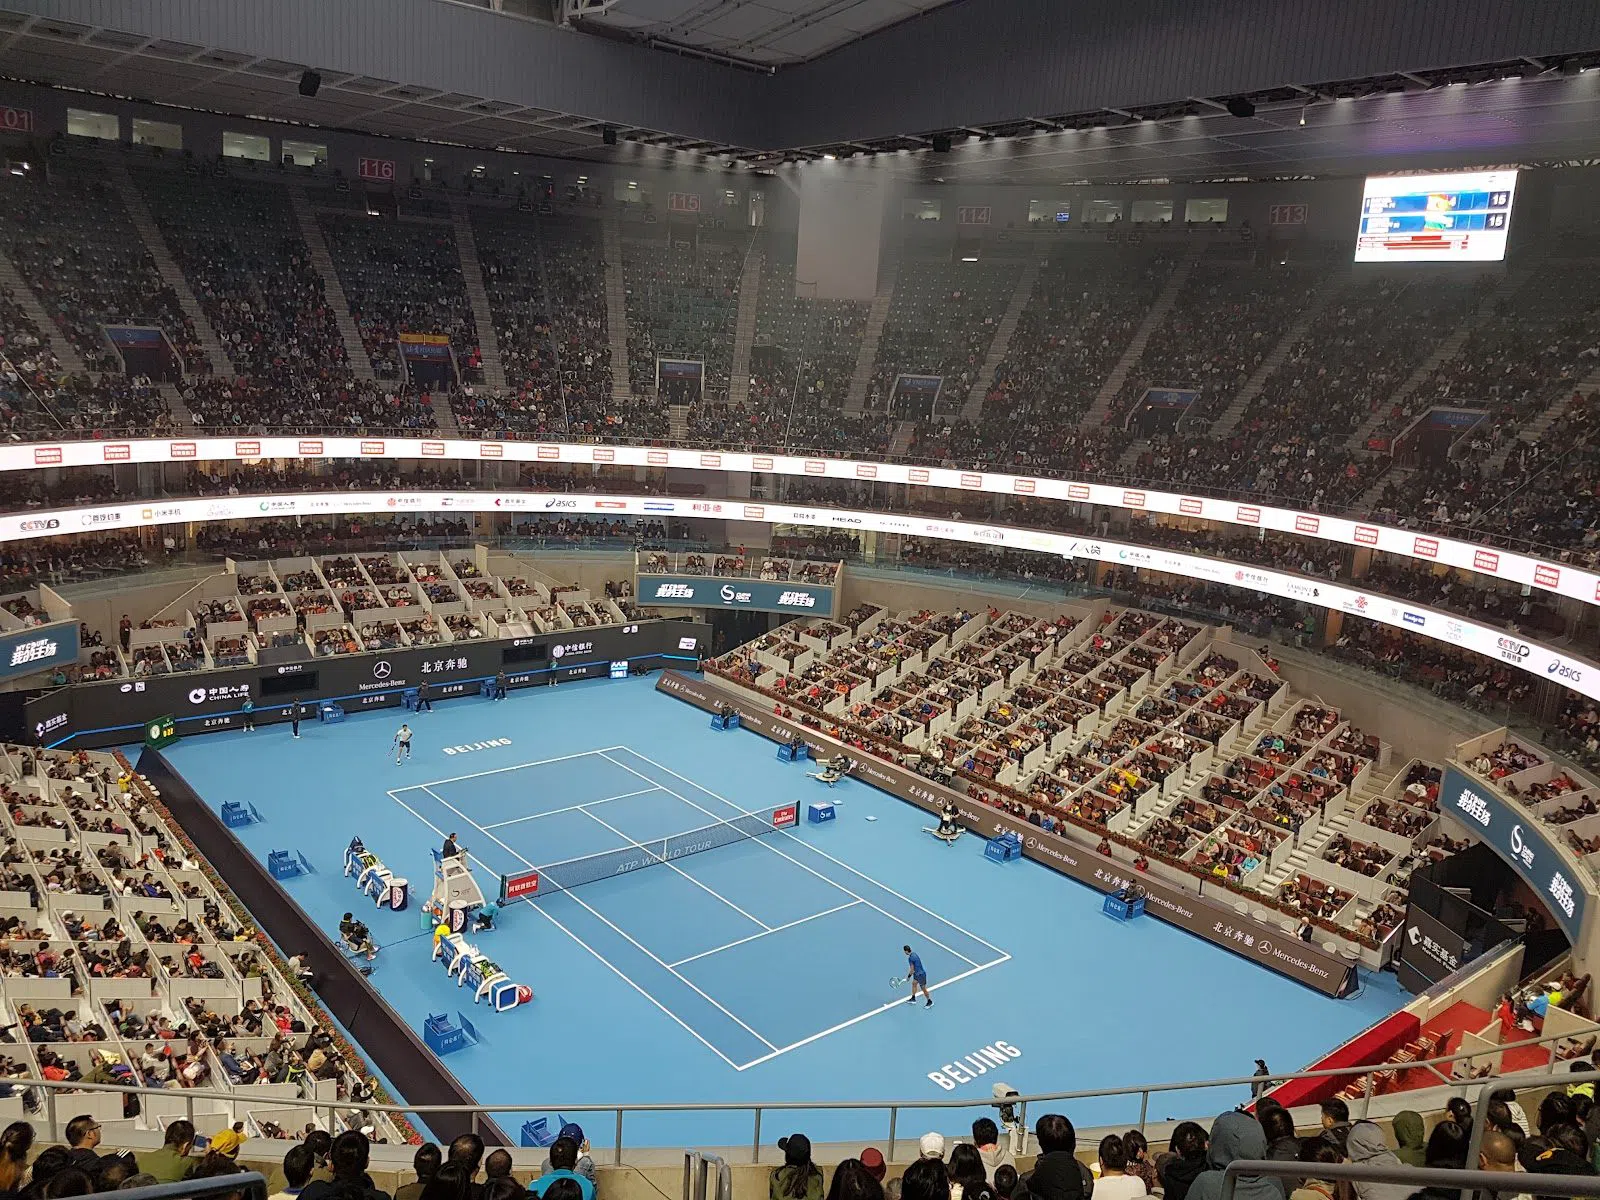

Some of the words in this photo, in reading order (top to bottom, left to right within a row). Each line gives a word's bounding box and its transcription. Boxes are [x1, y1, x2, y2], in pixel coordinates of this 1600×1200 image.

[361, 160, 393, 178] 116
[670, 195, 699, 211] 115
[1492, 193, 1507, 206] 15
[959, 208, 989, 224] 114
[1272, 206, 1305, 223] 113
[1488, 216, 1503, 229] 15
[20, 518, 60, 531] CCTV5
[832, 516, 862, 524] HEAD
[10, 643, 57, 667] 我的主场
[565, 642, 593, 652] 中信银行
[421, 657, 468, 673] 北京奔驰
[209, 684, 250, 696] 中国人寿
[359, 679, 406, 691] Mercedes-Benz
[442, 737, 513, 756] BEIJING
[908, 785, 936, 803] 北京奔驰
[615, 861, 639, 874] ATP
[641, 848, 684, 867] WORLD
[684, 840, 712, 855] TOUR
[1036, 842, 1078, 867] Mercedes-Benz
[508, 879, 537, 894] 阿联酋航空
[1094, 868, 1130, 890] 北京奔驰
[1144, 891, 1194, 919] Mercedes-Benz
[1212, 921, 1255, 947] 北京奔驰
[1272, 947, 1329, 979] Mercedes-Benz
[1423, 936, 1458, 969] 嘉实基金
[928, 1040, 1022, 1091] BEIJING
